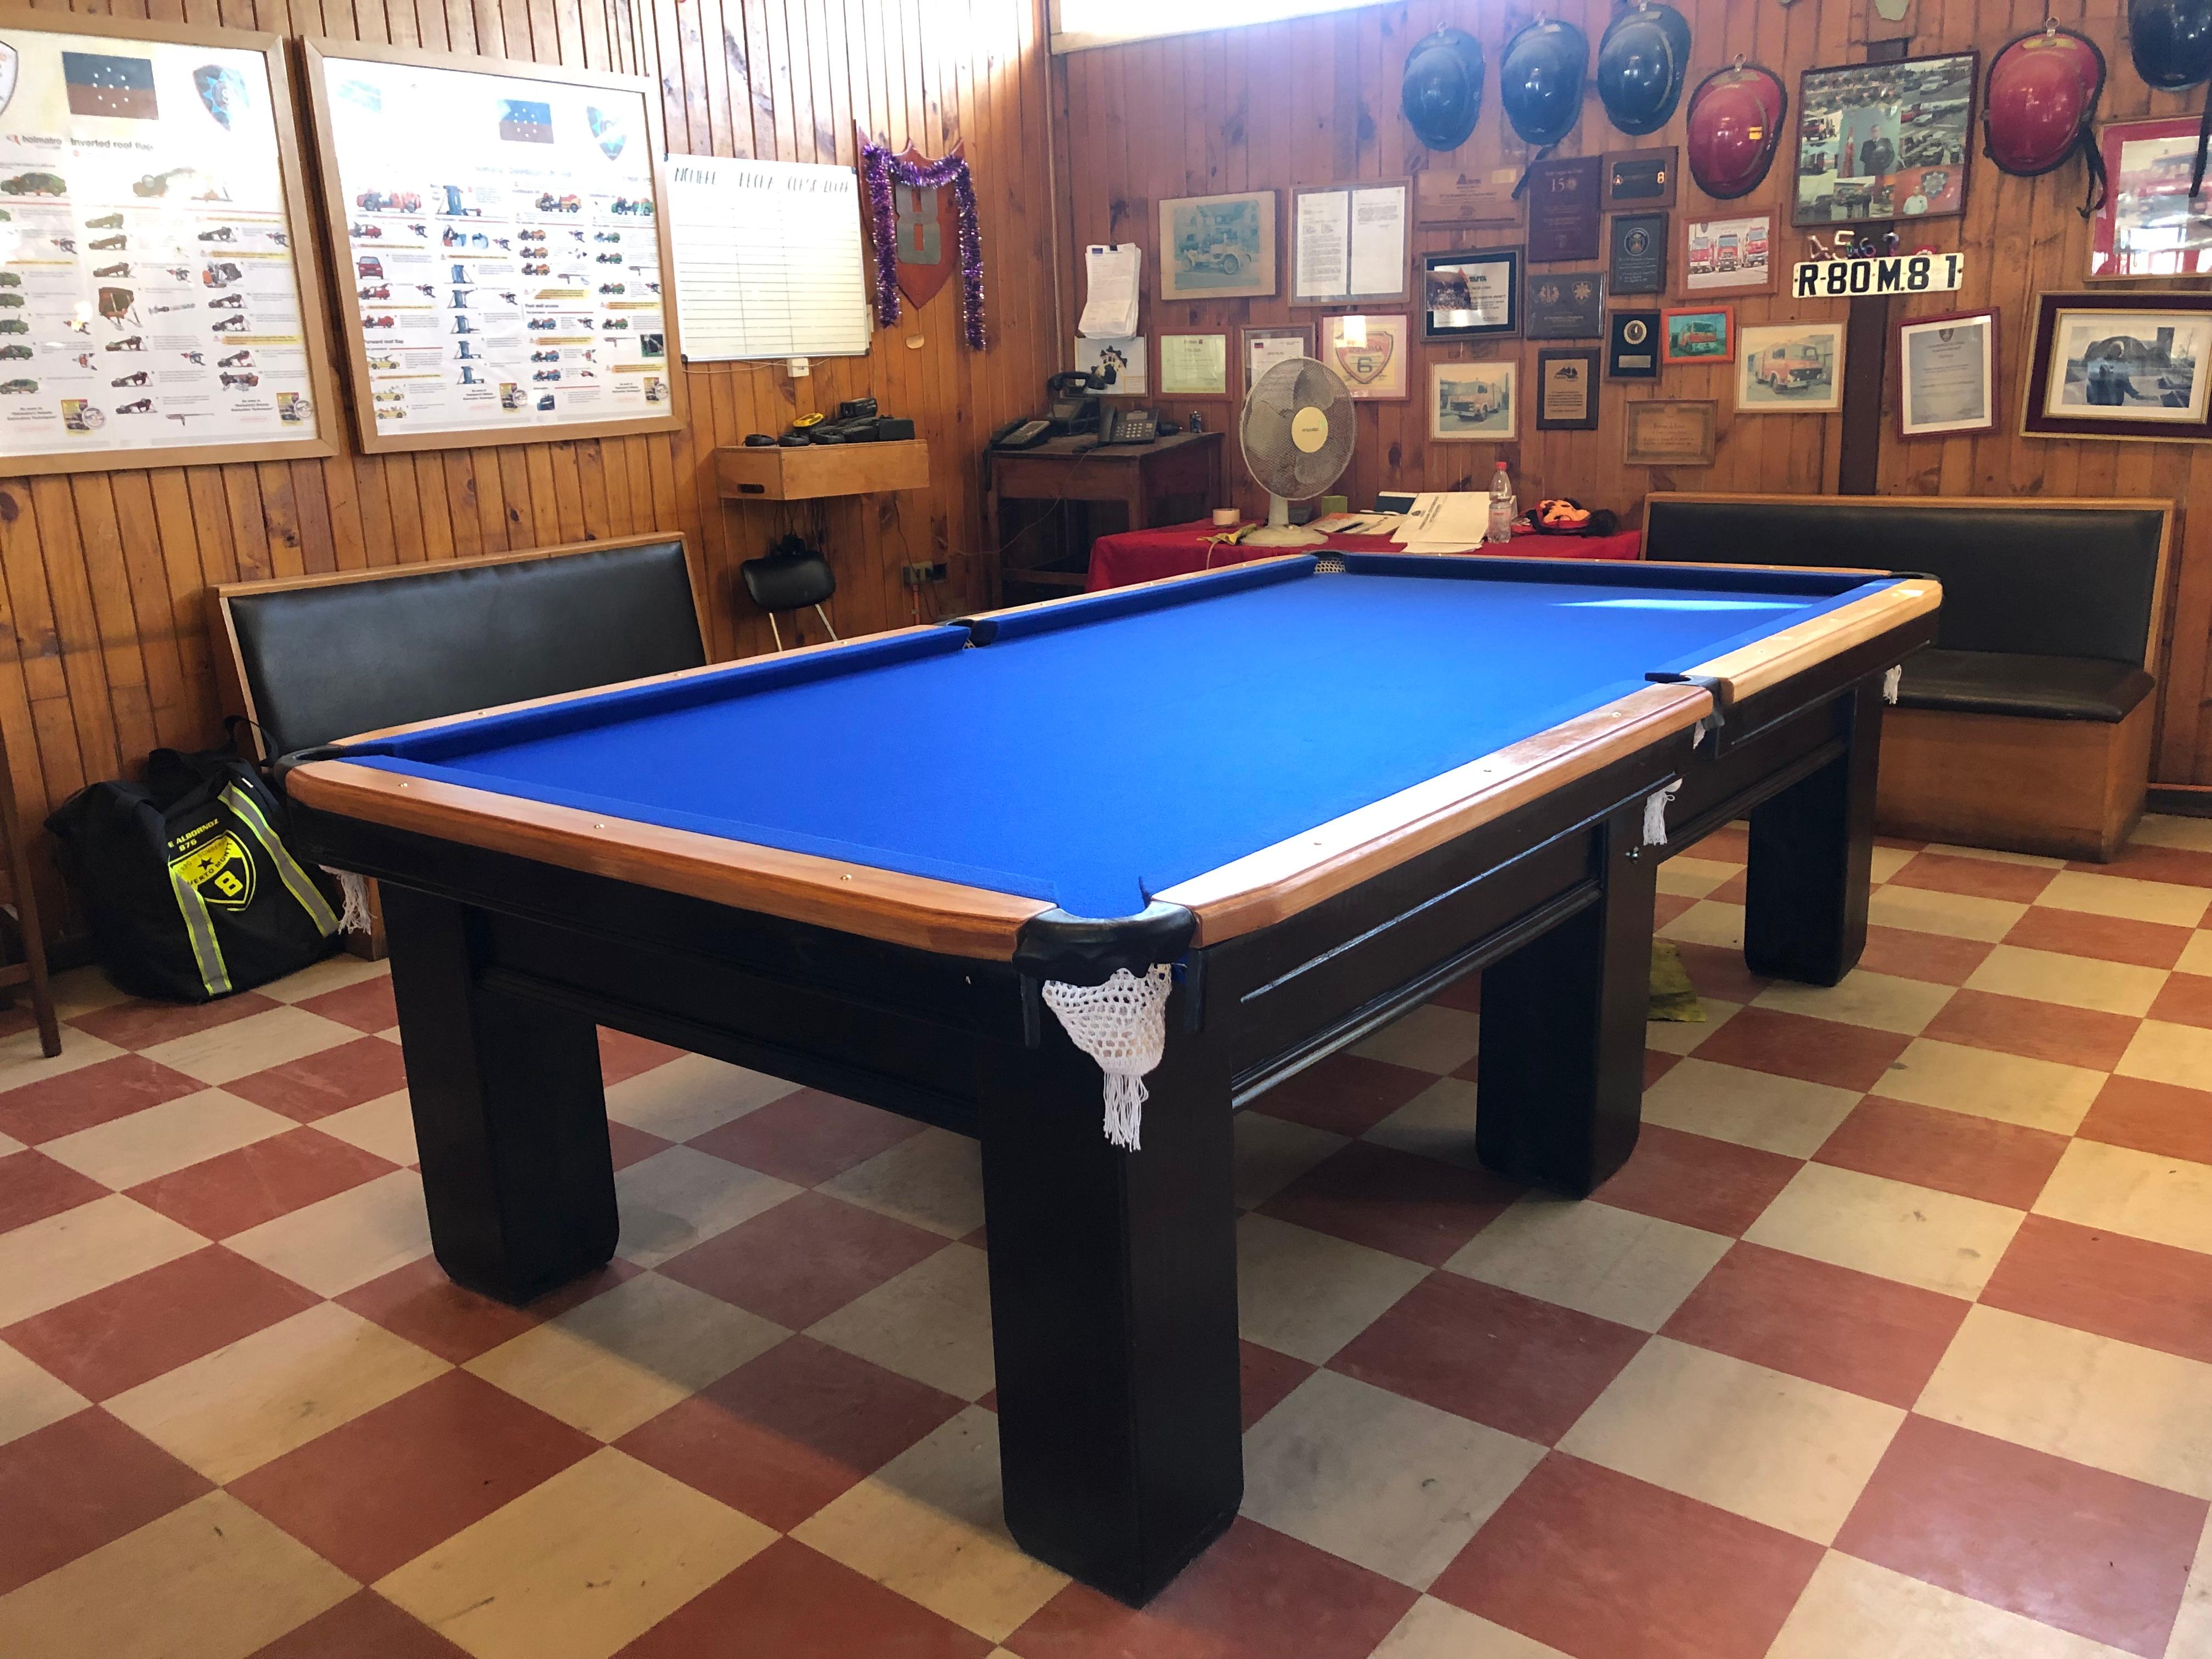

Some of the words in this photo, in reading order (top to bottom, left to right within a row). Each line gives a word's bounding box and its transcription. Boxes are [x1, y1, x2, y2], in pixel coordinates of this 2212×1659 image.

[70, 137, 110, 148] Inverted
[113, 140, 132, 149] roof
[1657, 172, 1664, 184] 8
[895, 181, 941, 265] 8
[1357, 357, 1373, 374] 6
[176, 818, 219, 845] ALBORNOZ
[187, 868, 215, 885] UERTO
[215, 870, 244, 897] 8
